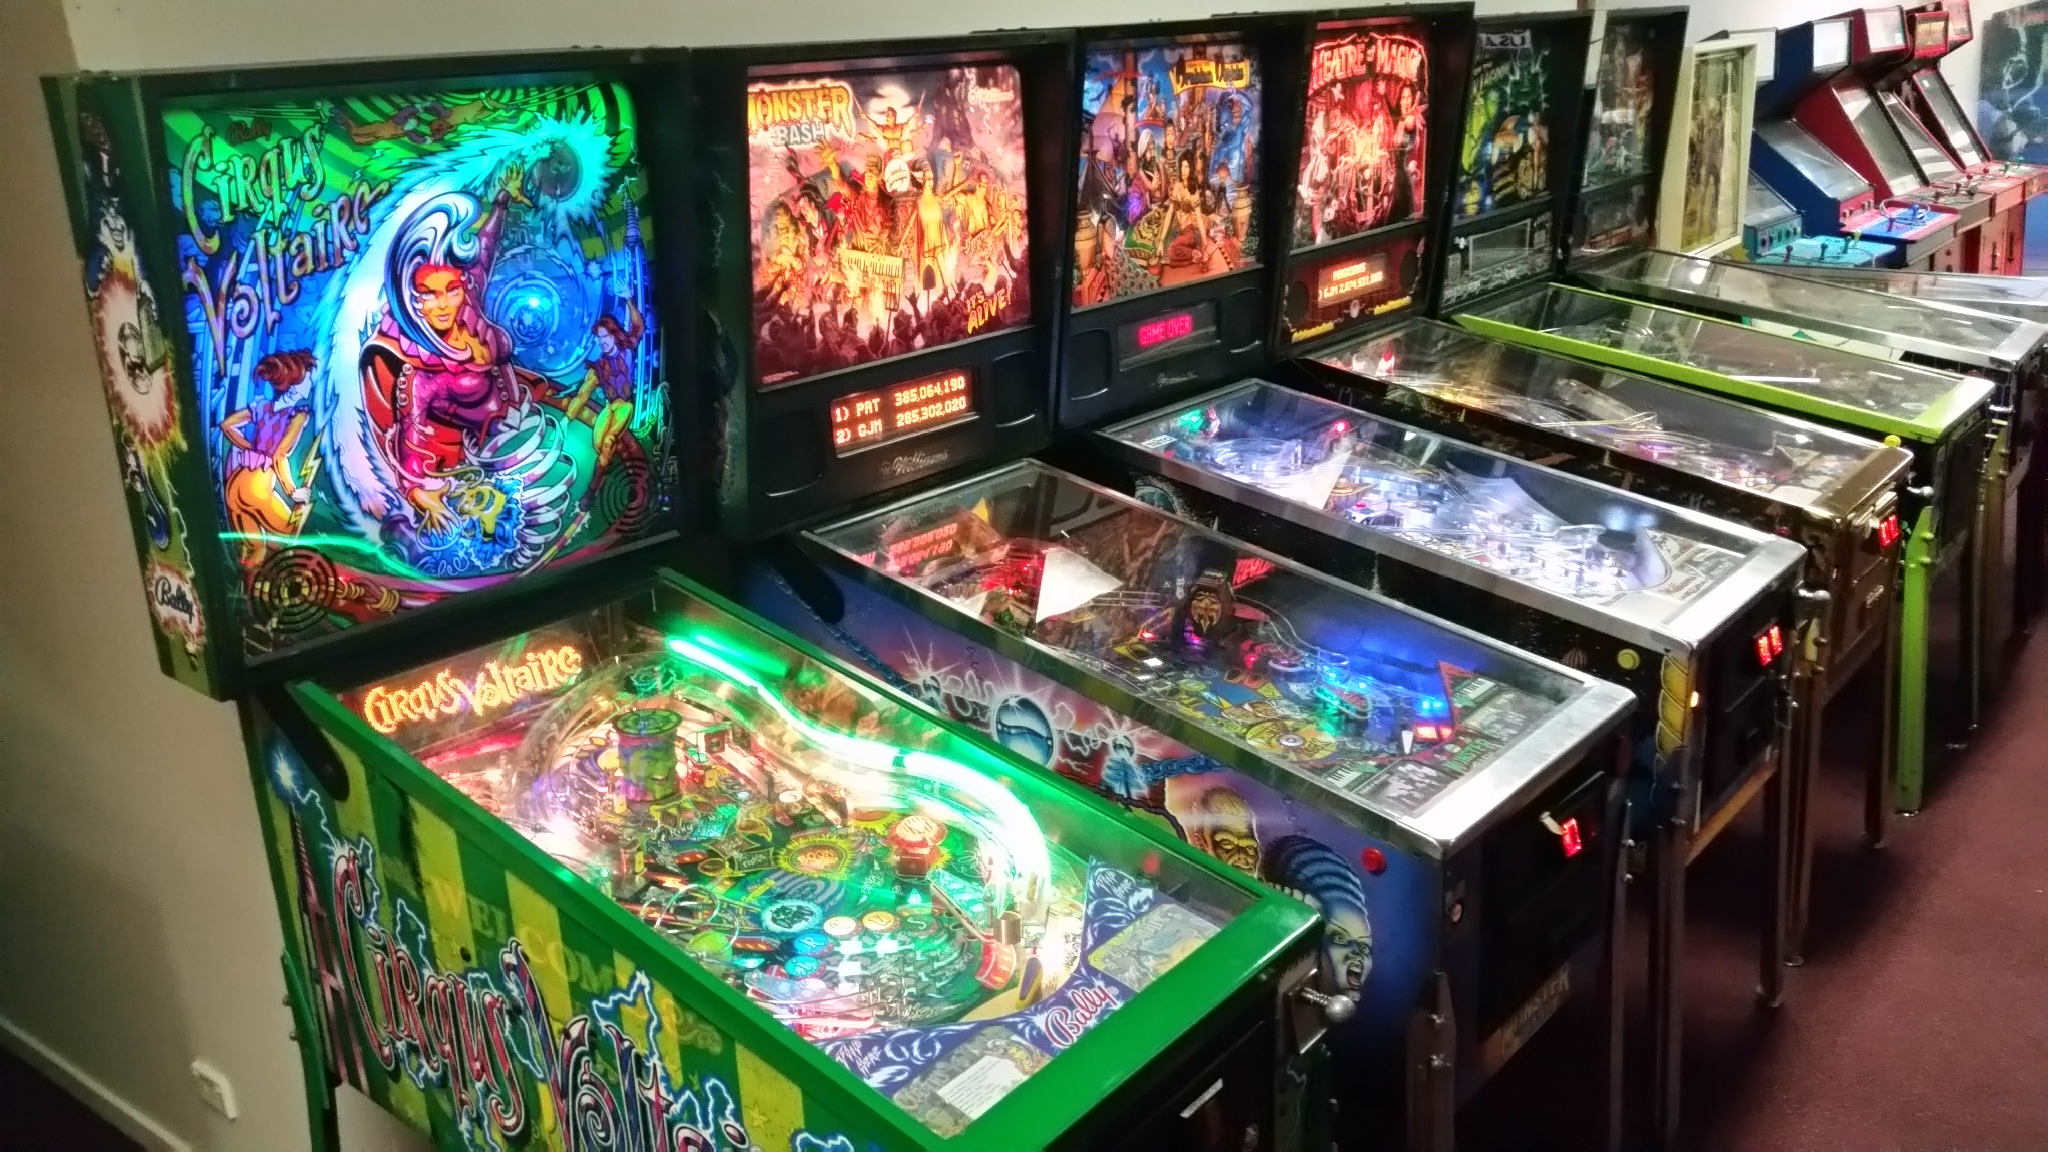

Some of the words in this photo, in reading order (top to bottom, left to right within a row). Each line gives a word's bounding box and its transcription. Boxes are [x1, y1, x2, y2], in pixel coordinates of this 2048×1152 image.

[775, 121, 828, 146] BASH
[1139, 323, 1166, 345] GAME
[1168, 315, 1192, 337] OVER
[835, 406, 849, 422] 1)
[856, 398, 881, 417] PAT
[894, 376, 965, 407] 385,064,190
[836, 429, 851, 444] 2)
[858, 419, 883, 438] GJM
[896, 396, 967, 427] 285,302,020
[893, 450, 948, 476] Williams
[1044, 984, 1118, 1047] Bally
